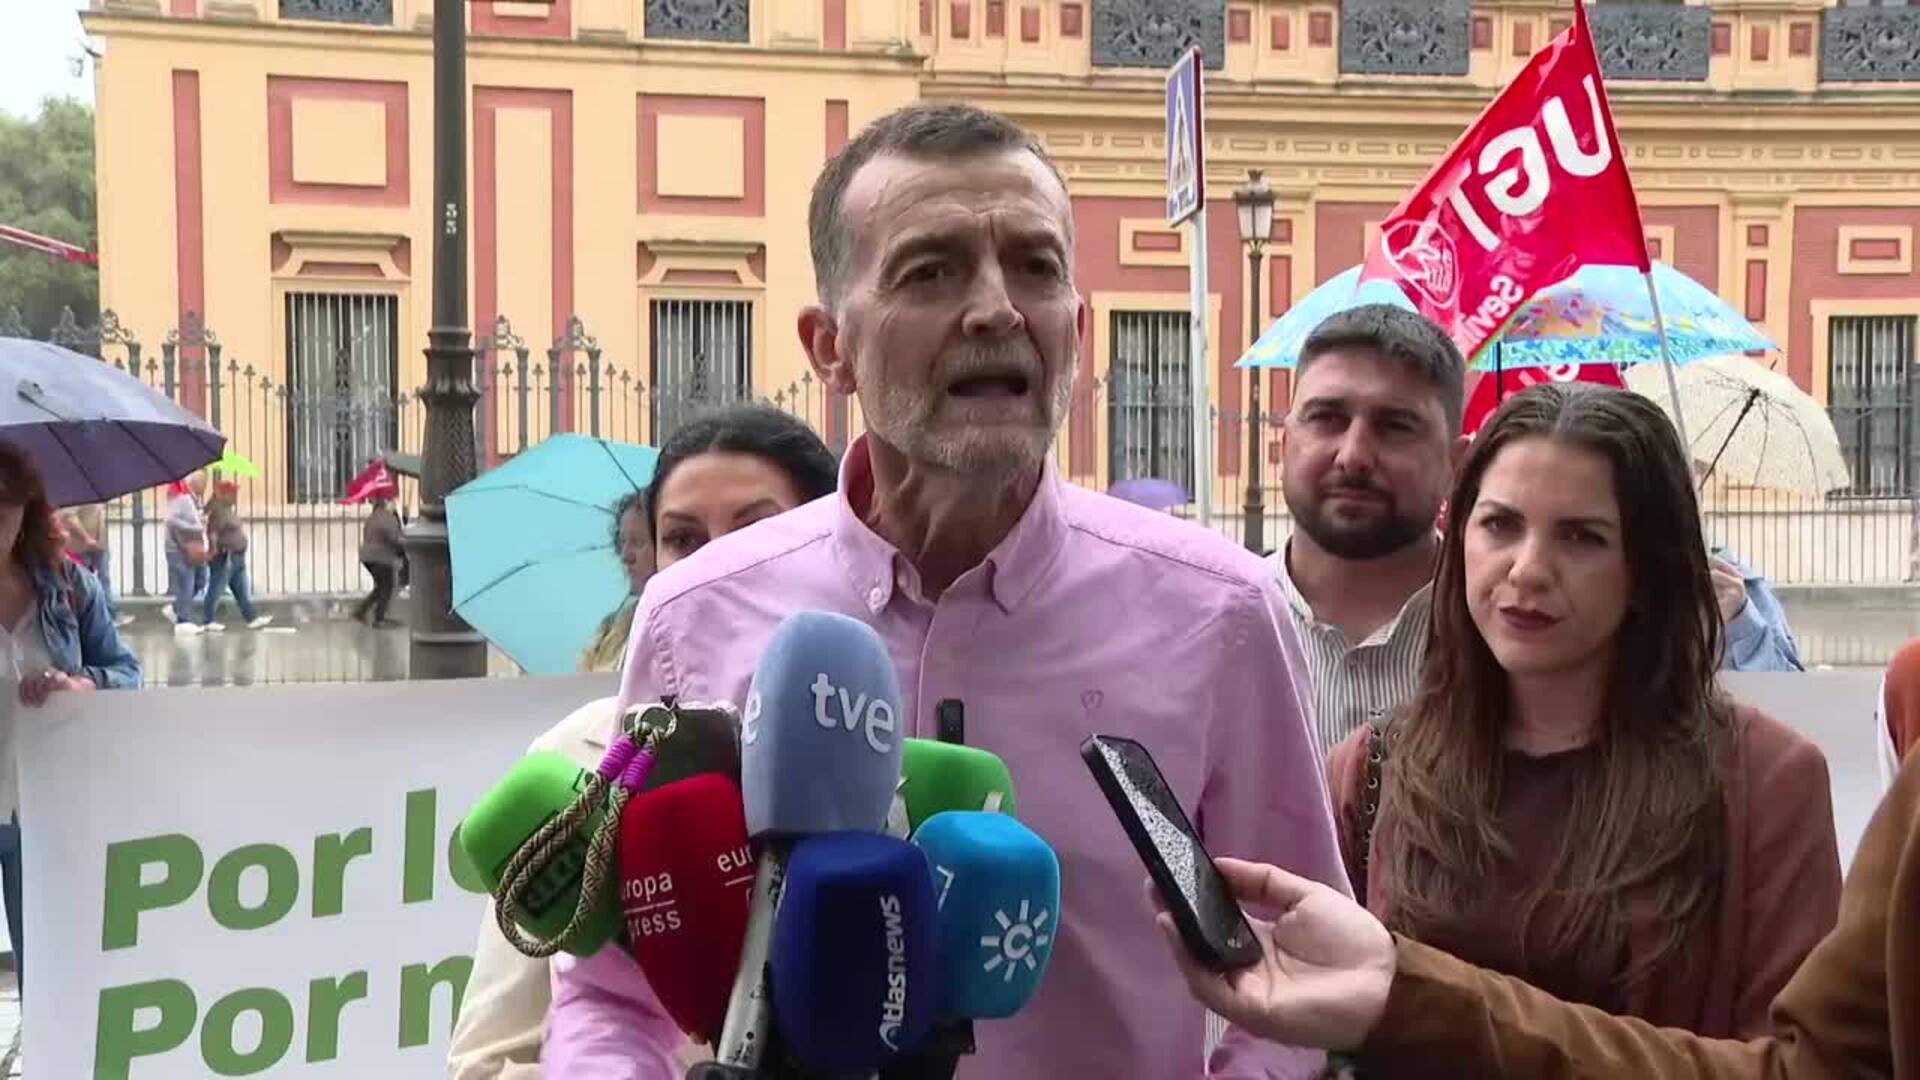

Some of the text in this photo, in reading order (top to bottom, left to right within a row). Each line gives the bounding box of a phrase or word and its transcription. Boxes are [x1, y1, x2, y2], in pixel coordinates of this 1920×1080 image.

[811, 672, 895, 754] tve
[101, 827, 373, 951] Por
[92, 970, 368, 1080] Por
